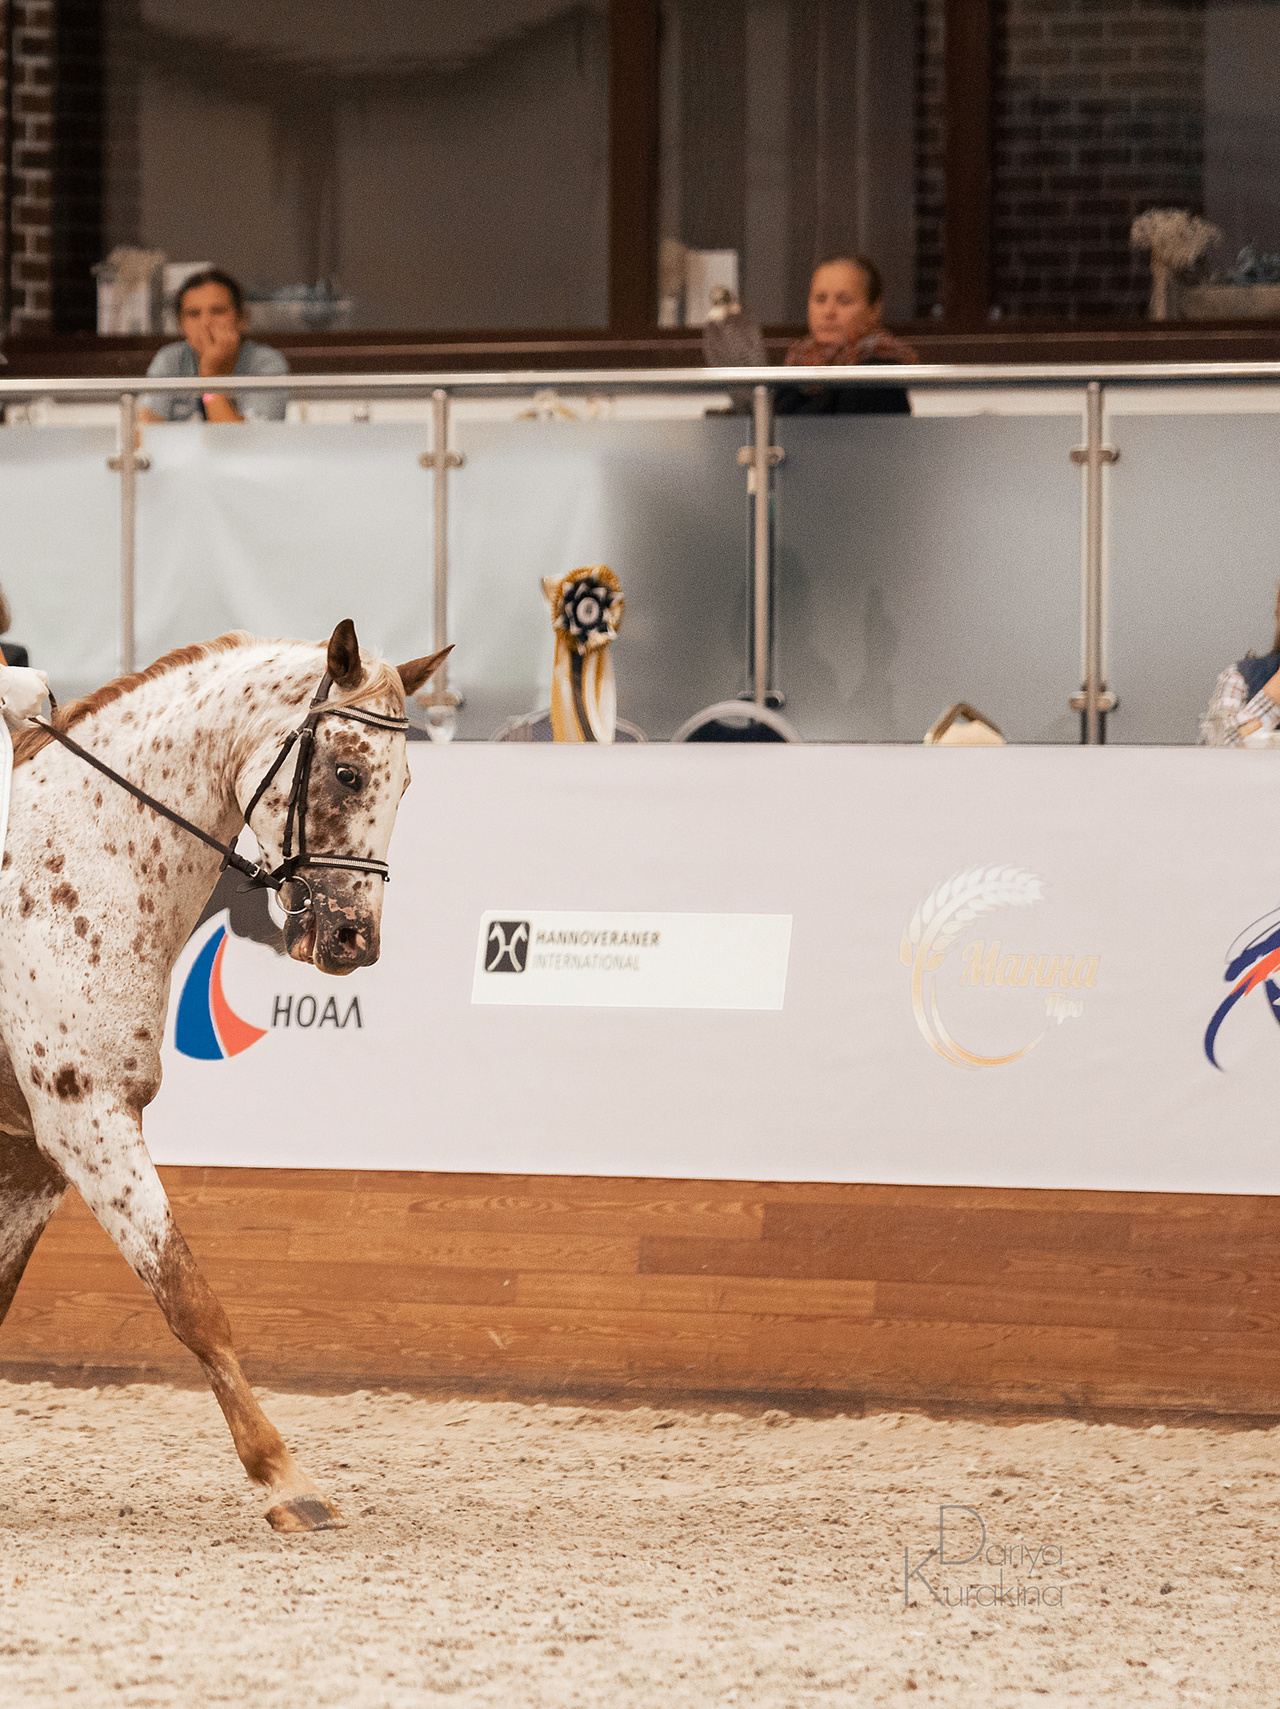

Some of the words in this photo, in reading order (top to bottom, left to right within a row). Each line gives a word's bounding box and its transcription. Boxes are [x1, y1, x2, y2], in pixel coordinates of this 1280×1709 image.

[535, 929, 661, 948] HANNOVERANER
[532, 953, 641, 972] INTERNATIONAL
[959, 939, 1101, 988] Манна
